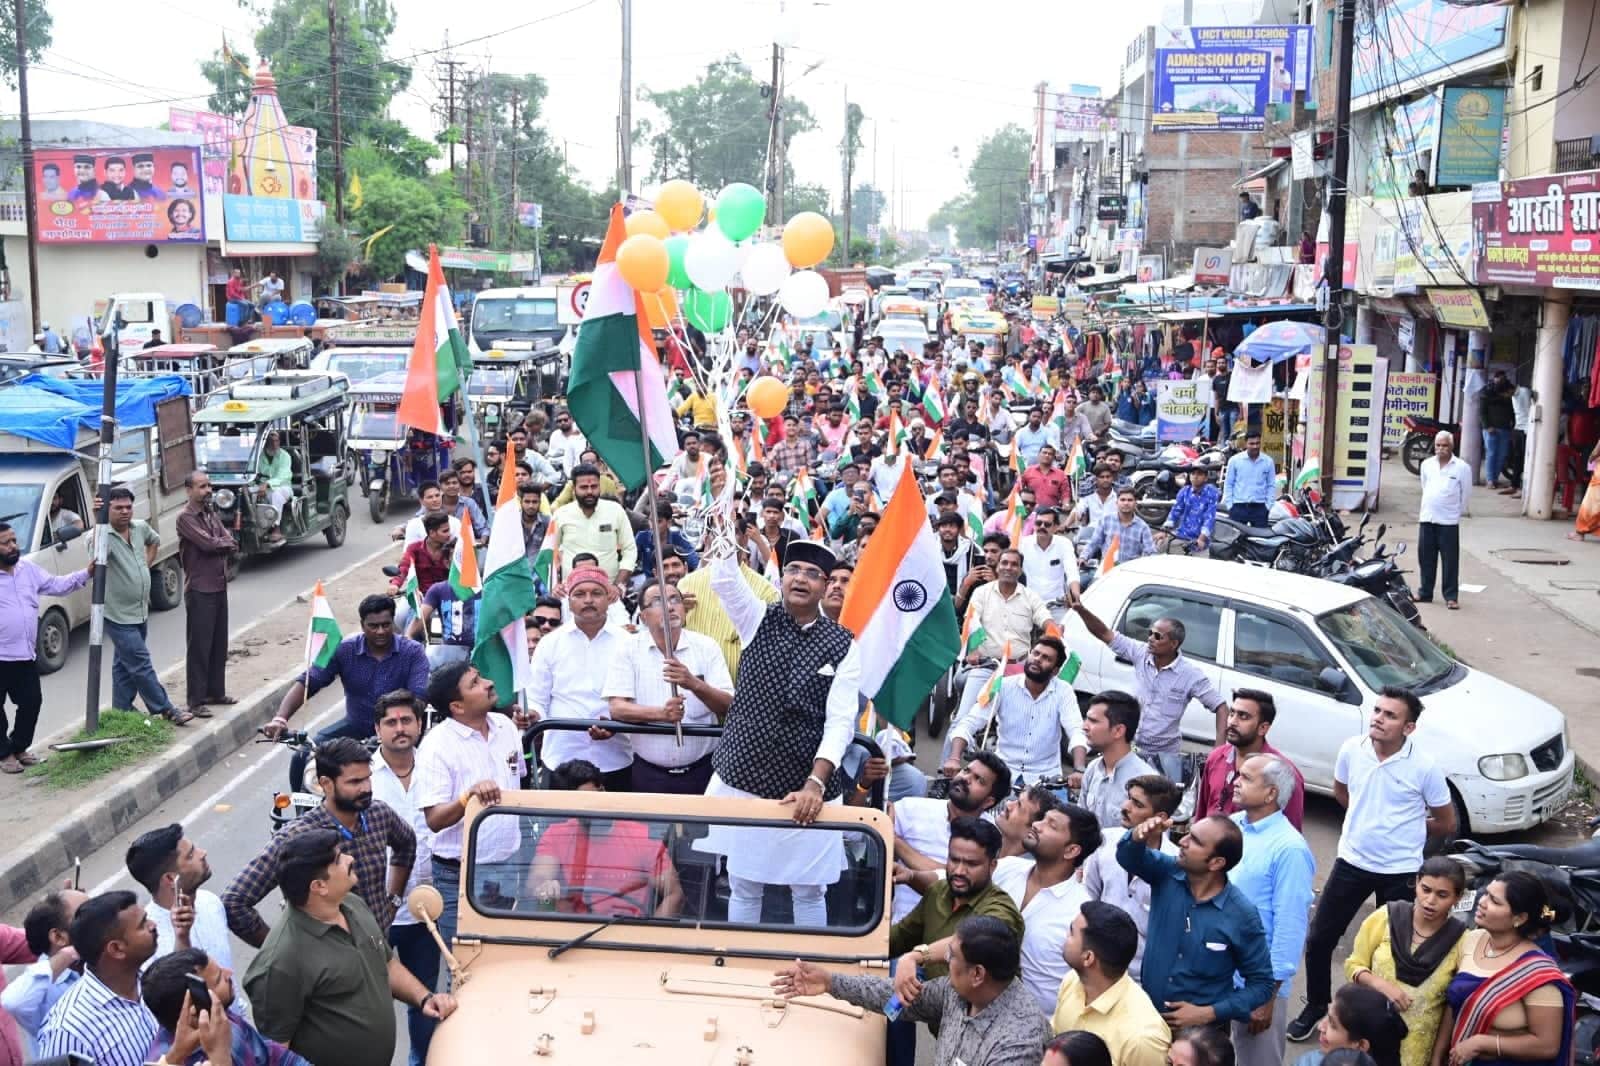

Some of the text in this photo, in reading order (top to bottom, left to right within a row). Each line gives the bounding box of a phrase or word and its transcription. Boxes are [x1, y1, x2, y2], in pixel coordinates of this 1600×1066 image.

[1222, 29, 1253, 39] WORLD
[1255, 29, 1289, 39] SCHOOL
[1167, 53, 1266, 66] ADMISSION OPEN
[1507, 183, 1565, 233] आरती
[1569, 191, 1600, 234] सा
